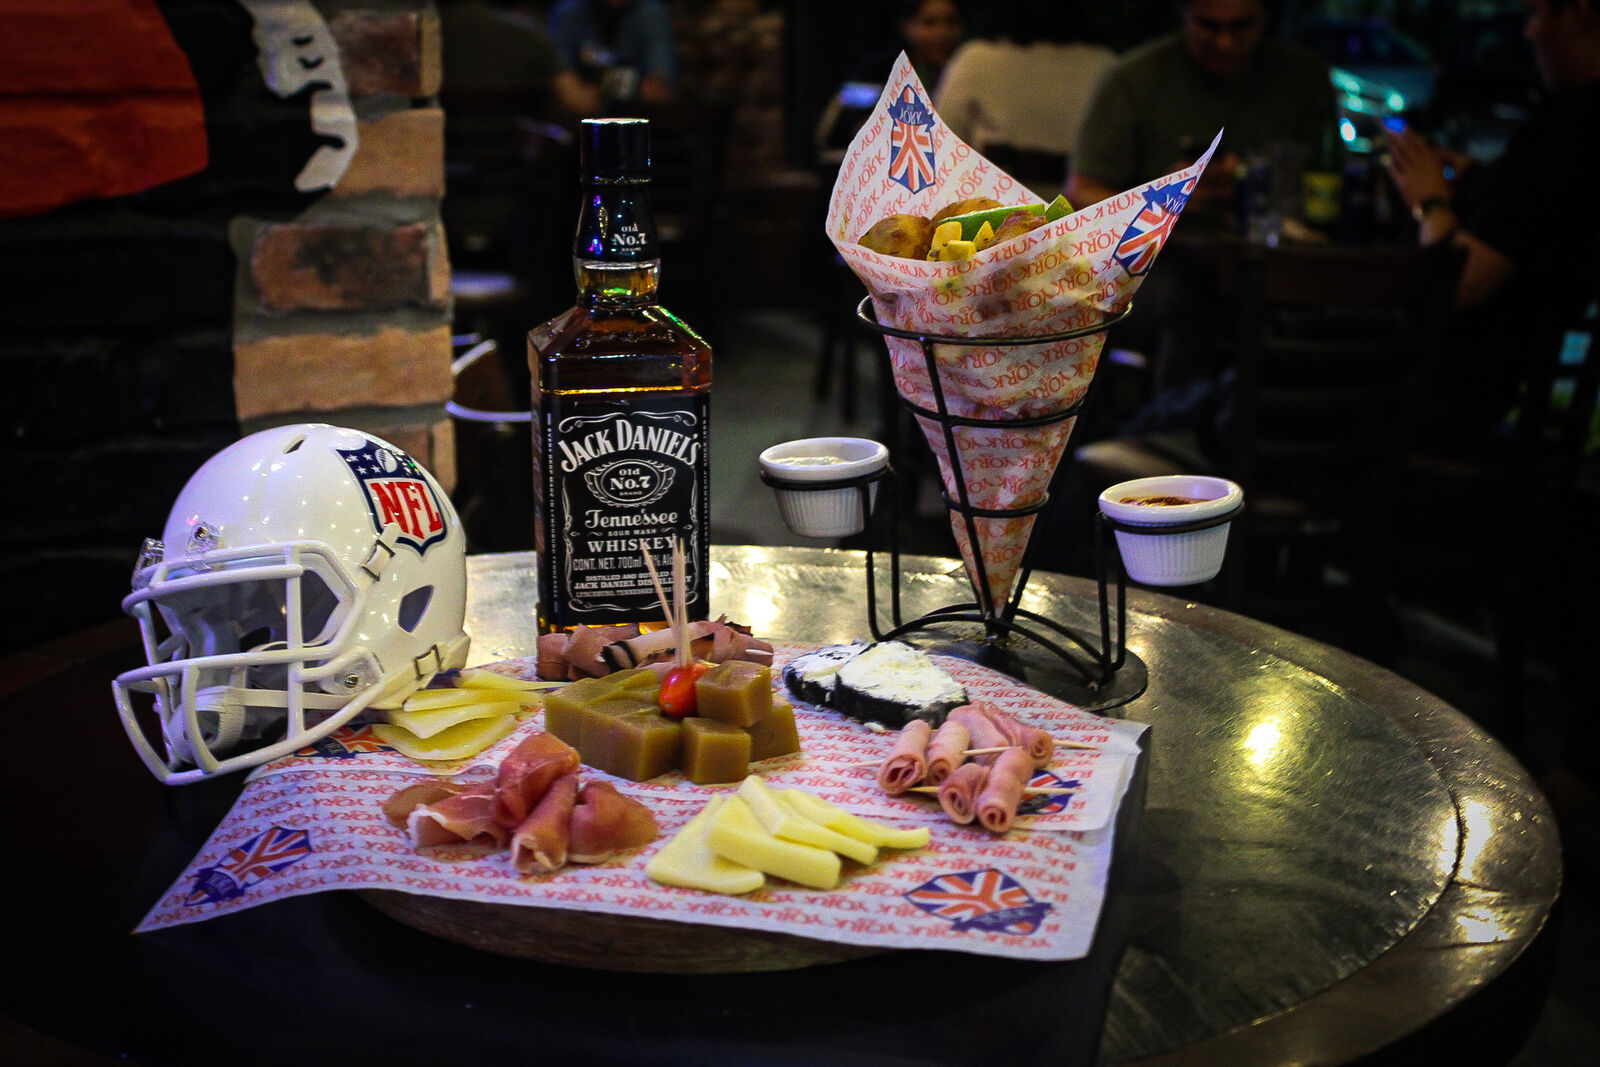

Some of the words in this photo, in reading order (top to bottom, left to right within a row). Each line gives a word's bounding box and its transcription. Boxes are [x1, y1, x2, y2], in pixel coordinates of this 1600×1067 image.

[1093, 192, 1142, 219] YORK
[1041, 214, 1090, 240] YORK
[988, 237, 1038, 265] YORK
[1071, 228, 1121, 256] YORK
[1019, 249, 1070, 278] YORK
[1050, 266, 1099, 290] YORK
[991, 359, 1040, 389] YORK
[1027, 371, 1070, 400] YORK
[557, 428, 616, 472] JACK
[609, 475, 651, 491] No.7
[370, 481, 443, 539] NFL
[584, 509, 678, 529] Tennessee
[587, 536, 676, 553] WHISKEY
